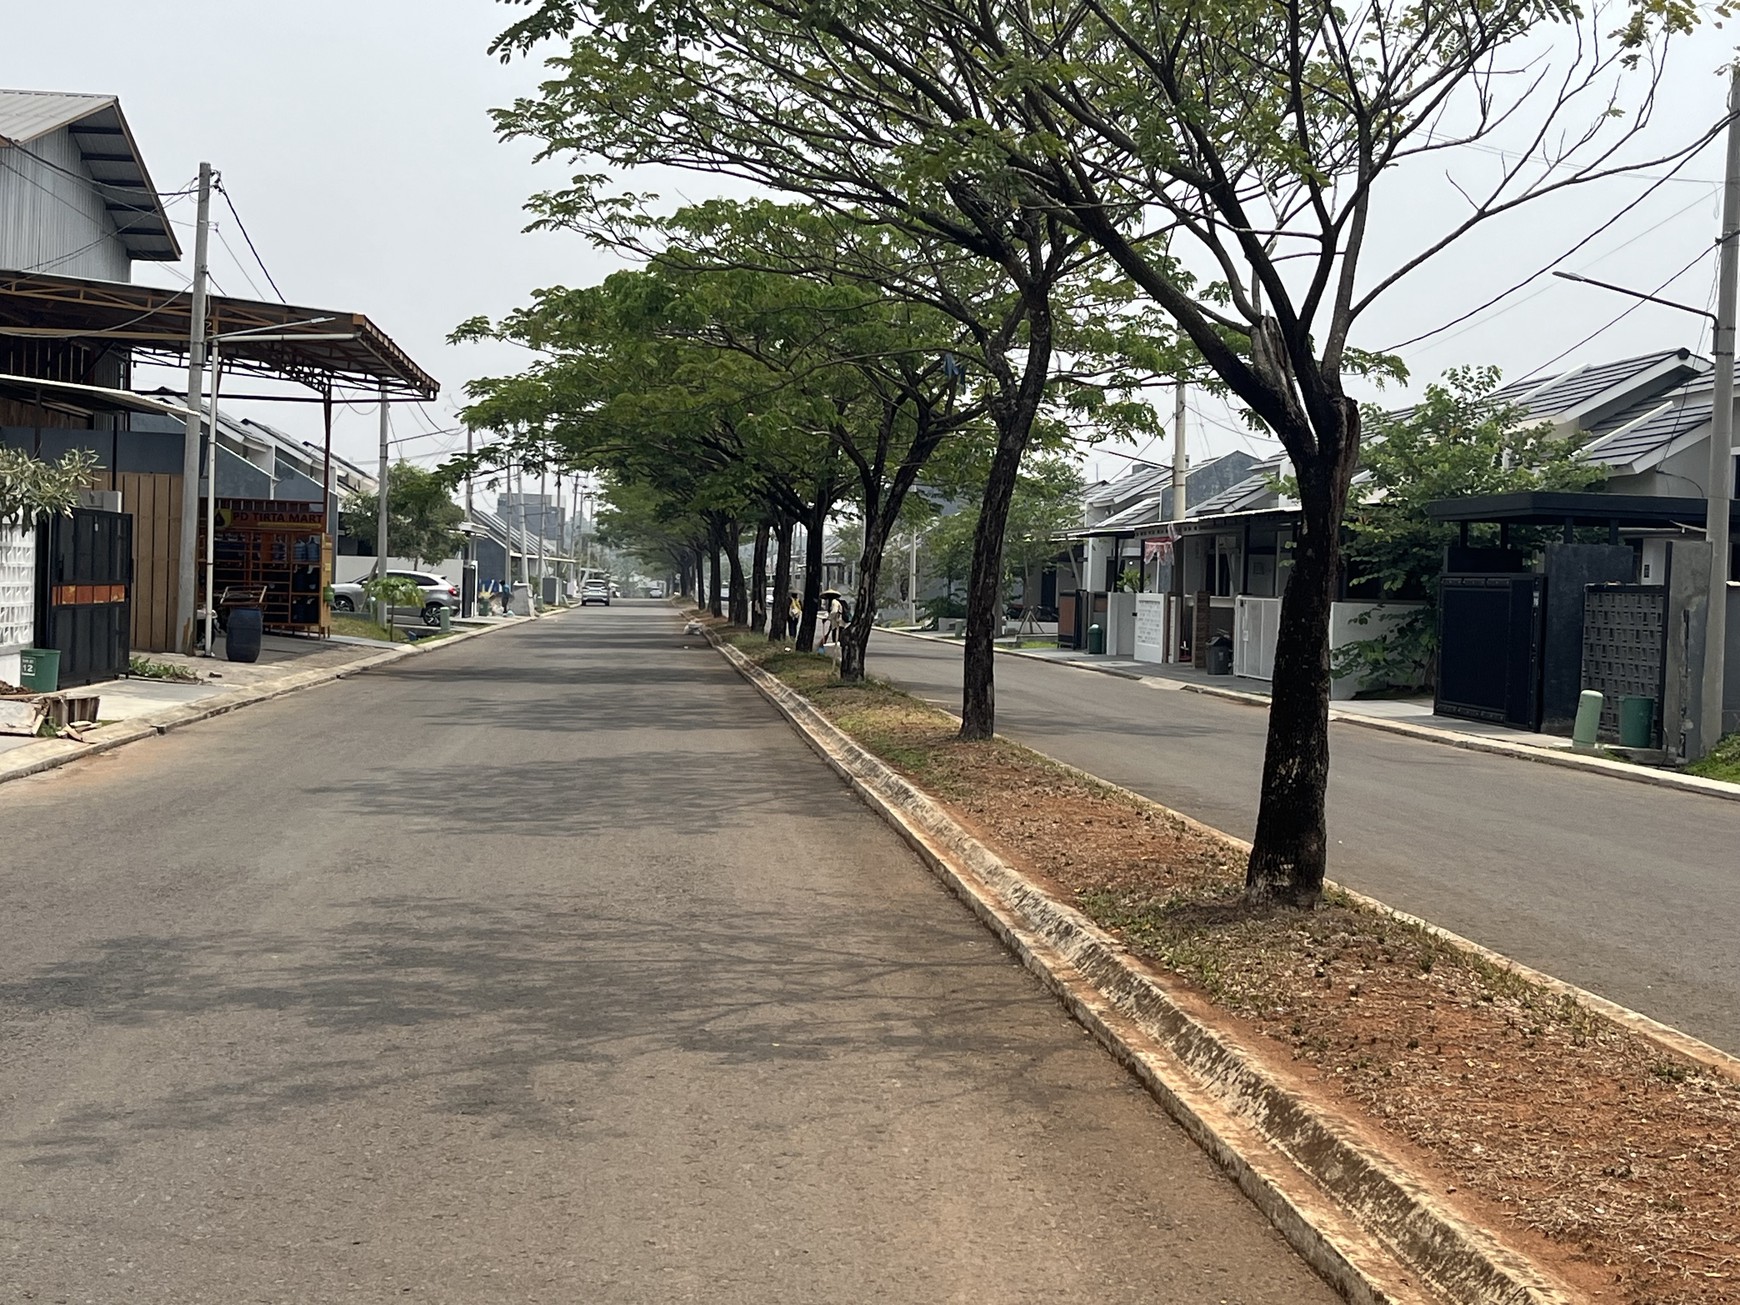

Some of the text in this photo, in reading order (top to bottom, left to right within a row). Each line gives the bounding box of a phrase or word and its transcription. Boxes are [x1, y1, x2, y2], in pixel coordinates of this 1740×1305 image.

[233, 512, 323, 523] PD TIRTA MART
[23, 664, 33, 672] 12
